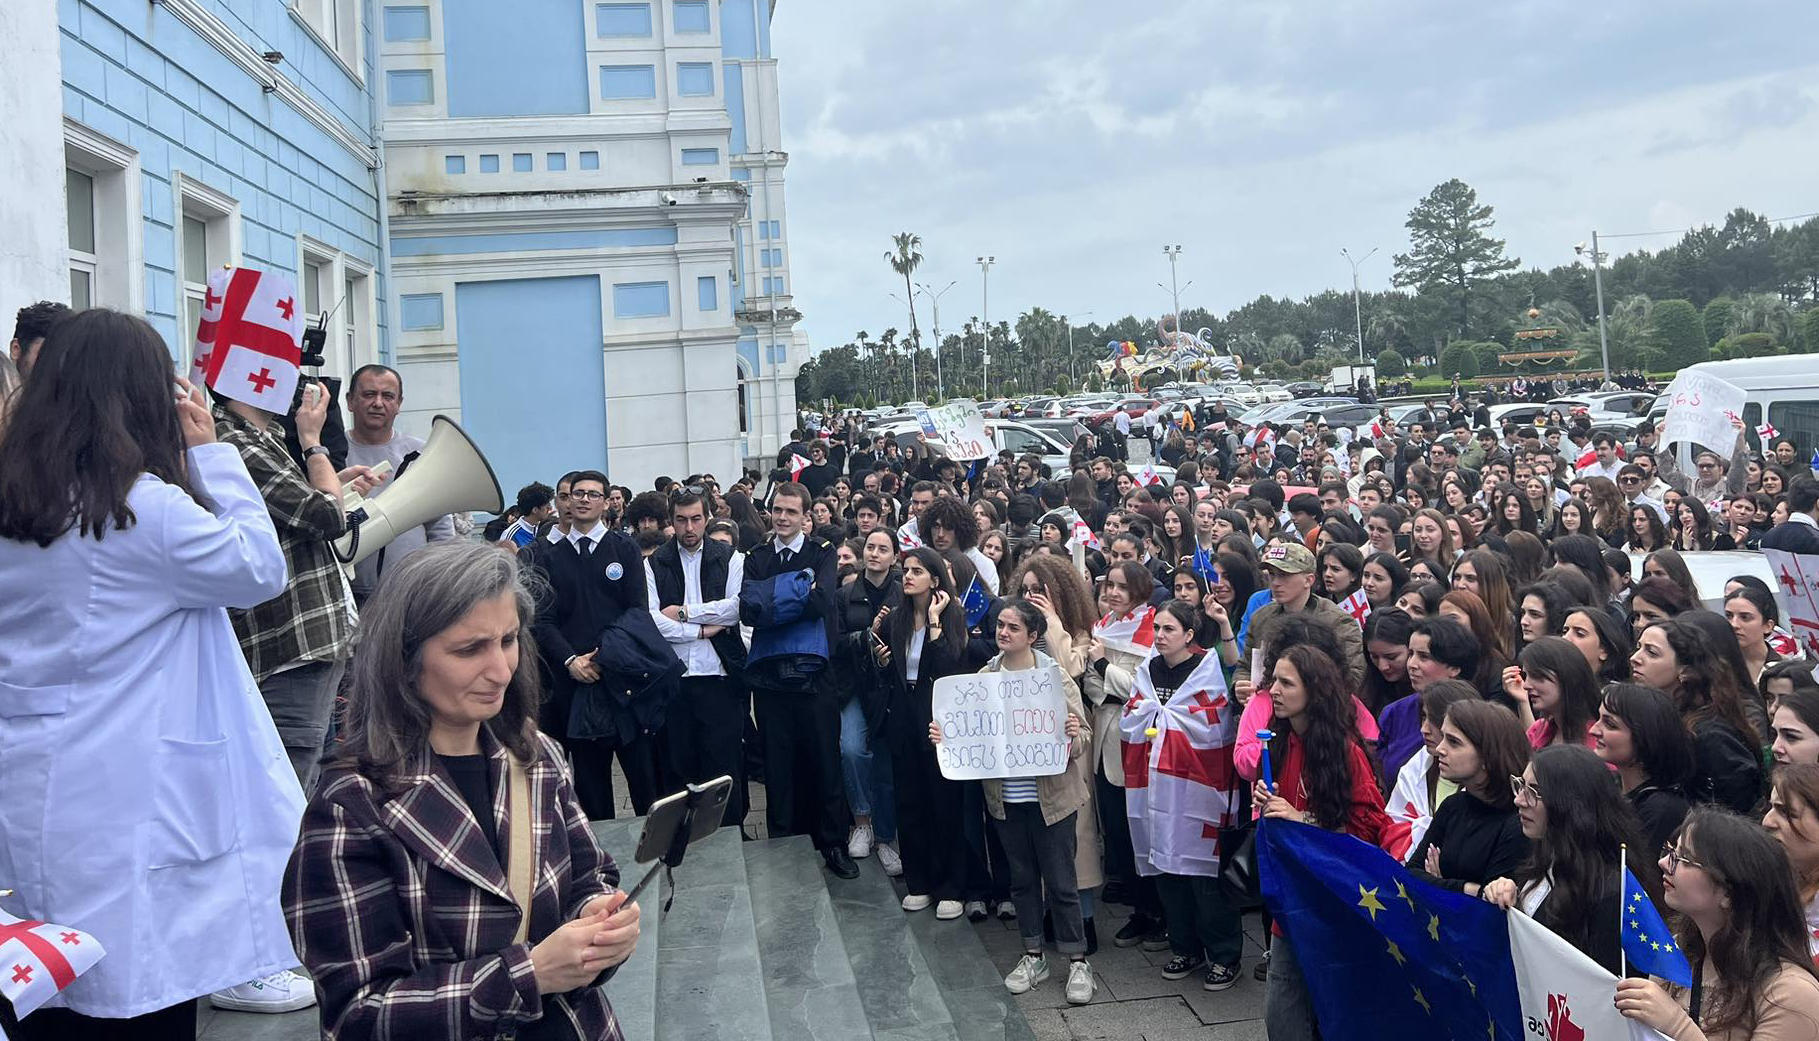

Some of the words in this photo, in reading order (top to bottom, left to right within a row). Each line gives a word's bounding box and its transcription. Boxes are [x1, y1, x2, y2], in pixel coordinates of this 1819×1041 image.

[938, 430, 959, 445] VS
[953, 681, 989, 705] არა
[1029, 672, 1053, 695] არ
[943, 709, 1005, 739] გესმით
[942, 744, 996, 770] მაინც
